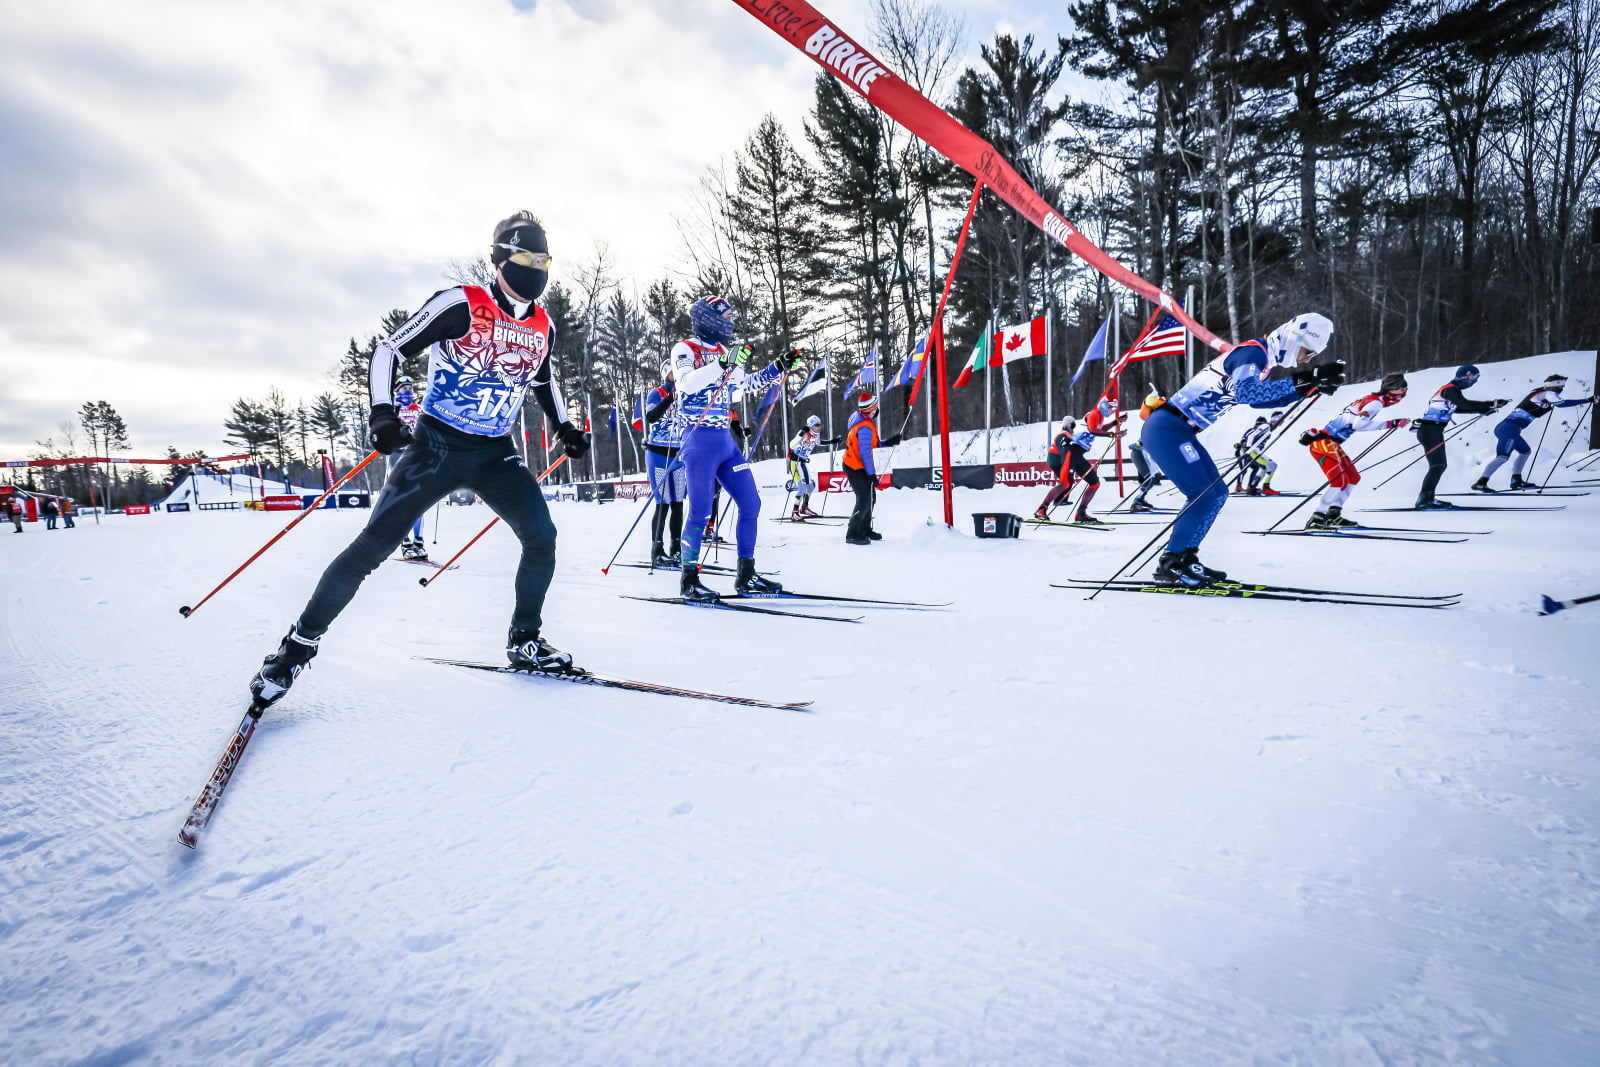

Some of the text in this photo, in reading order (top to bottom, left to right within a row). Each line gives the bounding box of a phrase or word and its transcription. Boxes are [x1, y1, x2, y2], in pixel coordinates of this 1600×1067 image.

[805, 24, 887, 96] BIRKIE
[1042, 211, 1074, 248] BIRKIE
[493, 326, 535, 349] BIRKIE
[473, 387, 522, 419] 177
[1139, 587, 1231, 597] FISCHER
